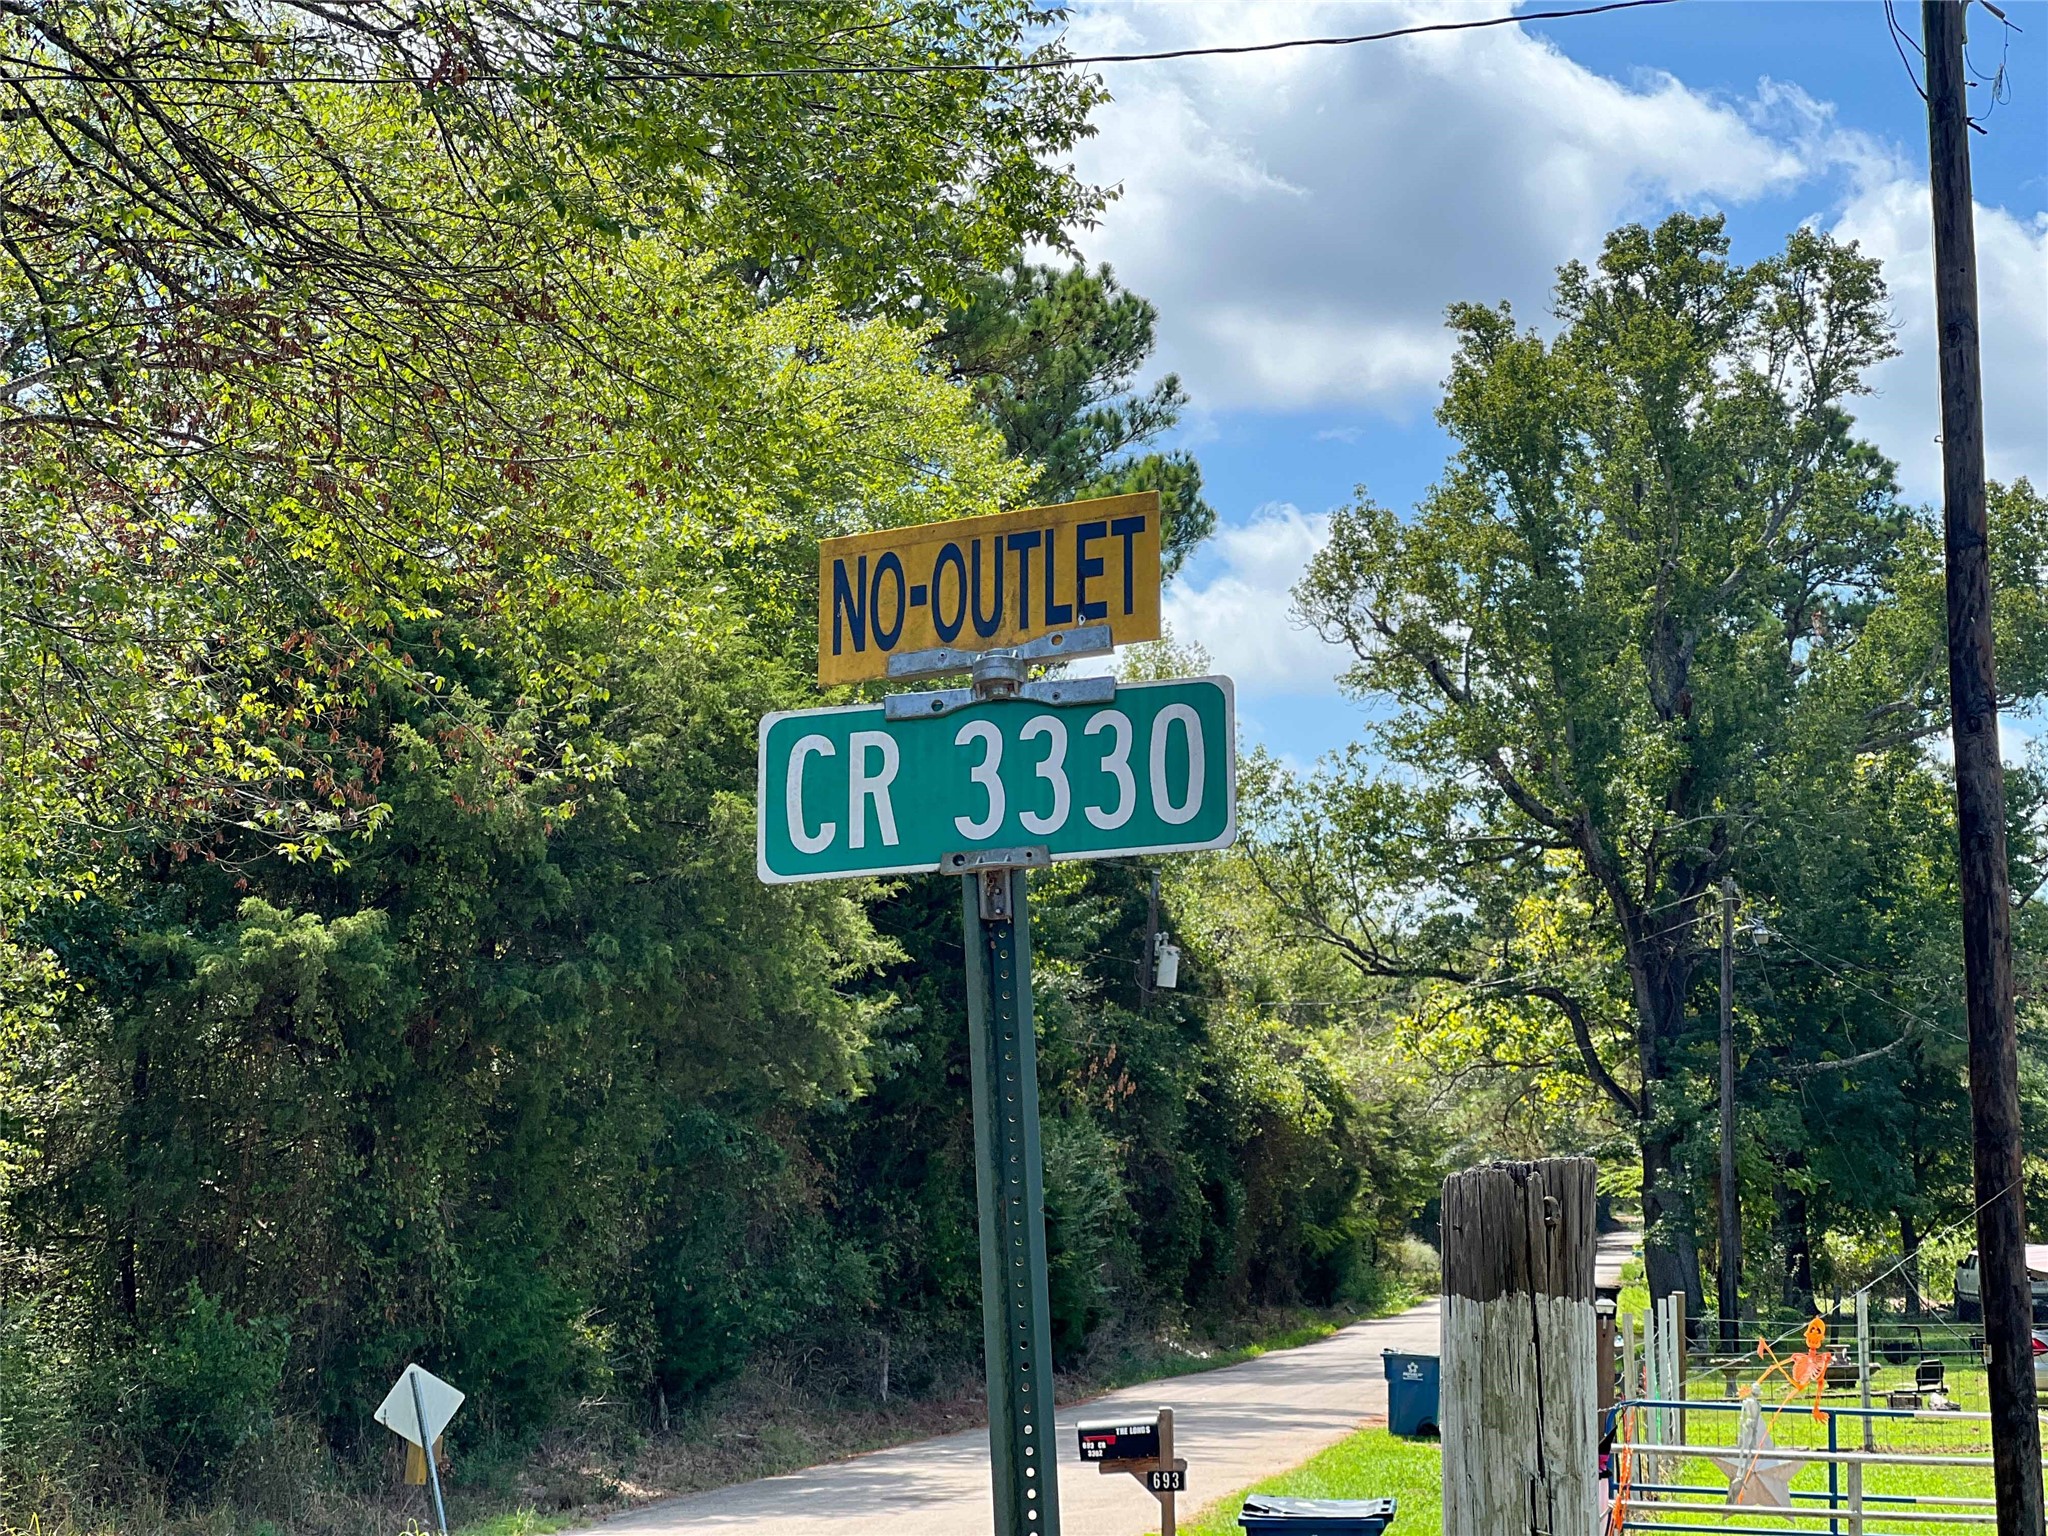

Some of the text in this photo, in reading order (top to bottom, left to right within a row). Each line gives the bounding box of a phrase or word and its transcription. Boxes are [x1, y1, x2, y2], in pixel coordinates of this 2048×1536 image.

[832, 515, 1146, 656] NO-OUTLET
[786, 703, 1206, 855] CR 3330
[1115, 1427, 1128, 1436] THE
[1097, 1441, 1107, 1449] CR
[1153, 1472, 1180, 1489] 693
